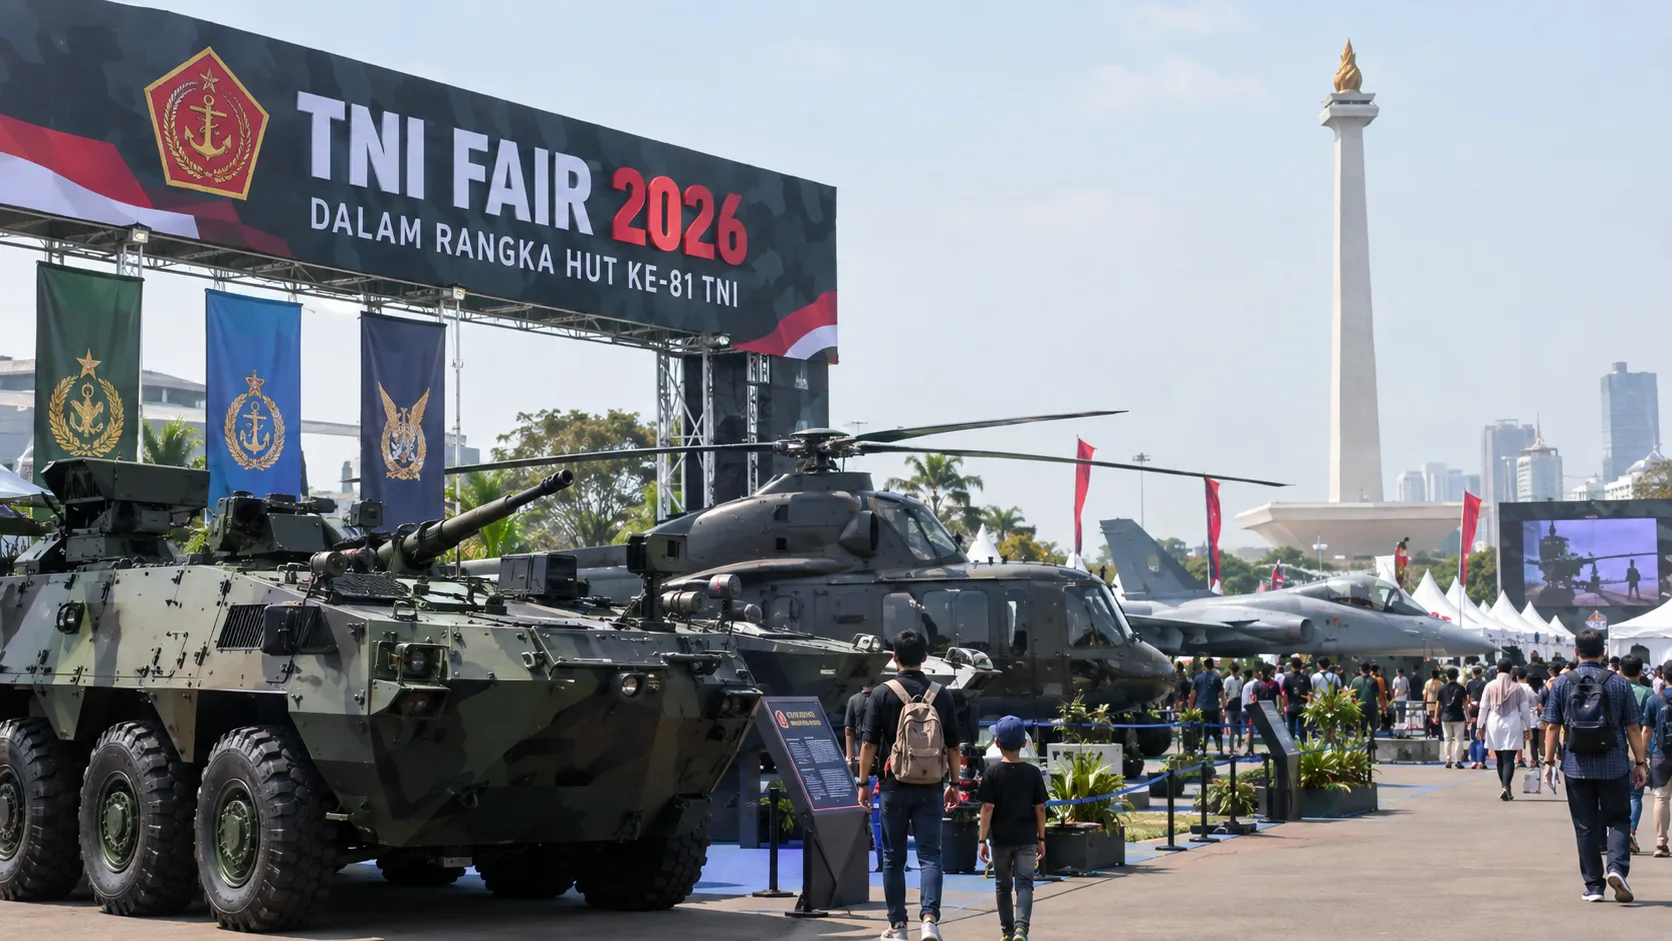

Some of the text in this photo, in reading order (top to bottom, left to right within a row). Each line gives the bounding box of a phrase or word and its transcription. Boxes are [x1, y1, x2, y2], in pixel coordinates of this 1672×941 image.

[297, 90, 748, 266] TNI FAIR 2026
[311, 197, 738, 308] DALAM RANGKA HUT KE-81 TNI
